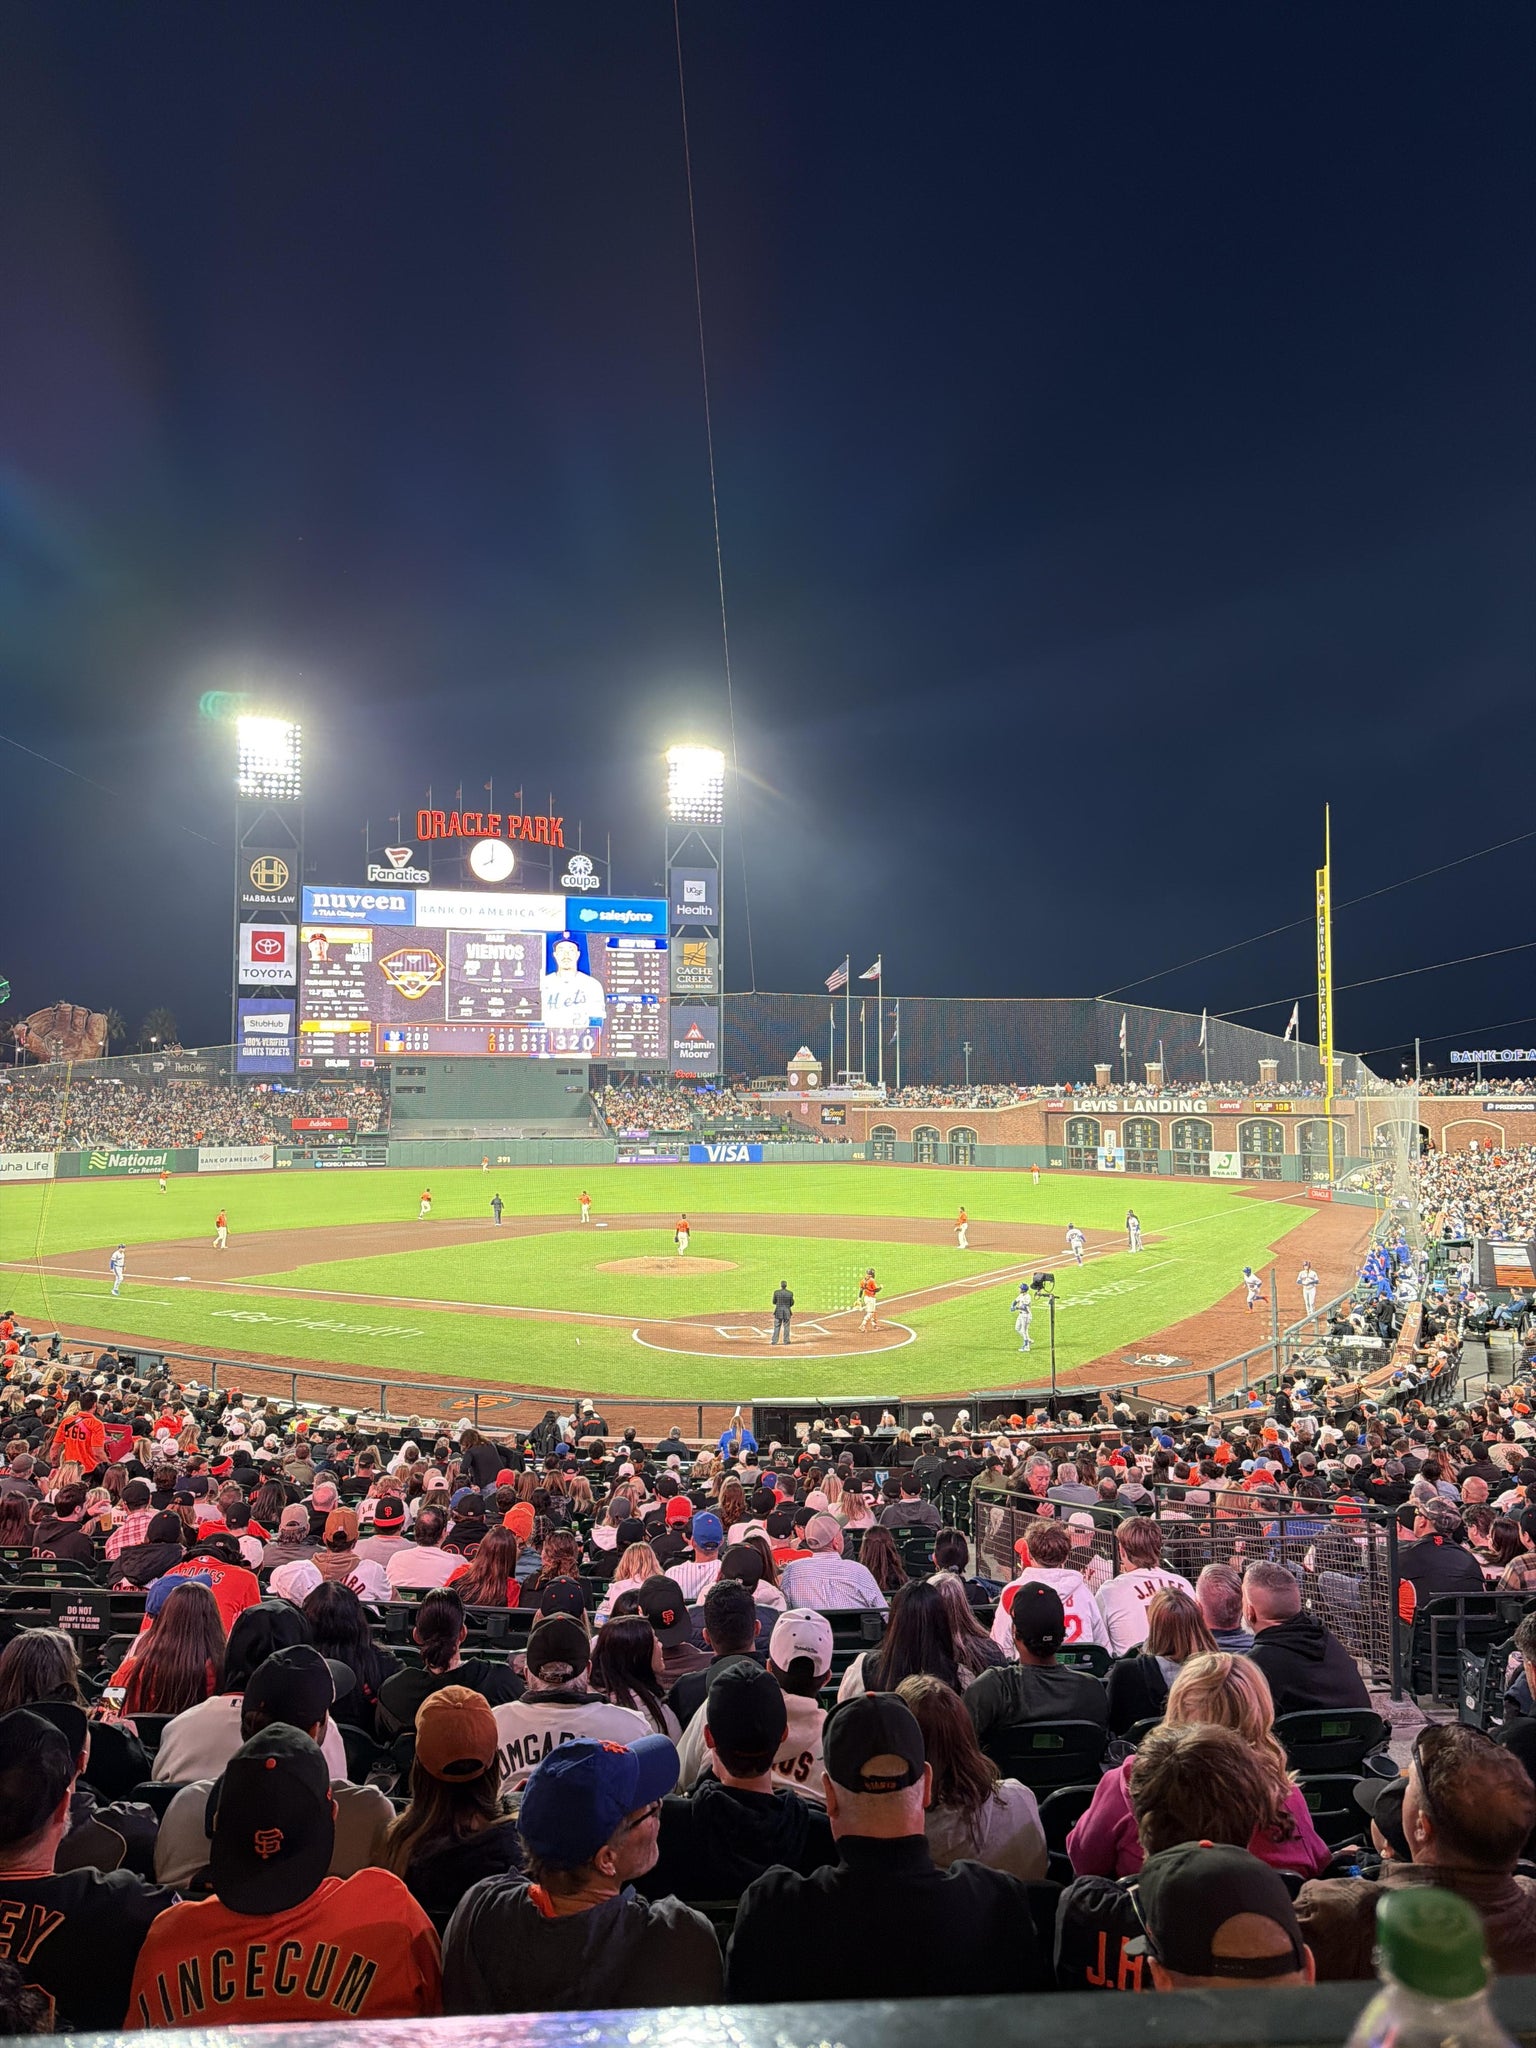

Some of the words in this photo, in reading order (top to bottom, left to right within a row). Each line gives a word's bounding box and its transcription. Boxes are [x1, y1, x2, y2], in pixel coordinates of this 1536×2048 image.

[417, 810, 501, 841] ORACLE
[508, 815, 564, 848] PARK
[370, 866, 428, 882] Fanatics
[563, 876, 598, 890] coupa
[242, 894, 276, 903] HABBAS
[278, 895, 295, 904] LAW
[312, 893, 406, 910] nuveen
[460, 906, 473, 915] OF
[478, 908, 535, 917] AMERICA
[677, 904, 712, 916] Health
[600, 910, 654, 924] salesforce
[466, 944, 525, 960] VIENTOS
[242, 968, 292, 978] TOYOTA
[676, 967, 713, 976] CACHE
[250, 1020, 284, 1028] StubHub
[262, 1038, 288, 1046] VERIFIED
[406, 1033, 412, 1041] 2
[415, 1033, 420, 1041] 0
[423, 1033, 429, 1041] 0
[489, 1033, 495, 1042] 2
[556, 1036, 566, 1049] 3
[570, 1036, 579, 1050] 2
[583, 1036, 594, 1050] 0
[406, 1042, 412, 1050] 0
[415, 1042, 420, 1050] 0
[423, 1042, 429, 1050] 0
[489, 1043, 495, 1051] 0
[674, 1040, 715, 1050] Benjamin
[243, 1048, 264, 1056] GIANTS
[265, 1048, 290, 1056] TICKETS
[680, 1050, 710, 1058] Moore
[1450, 1050, 1496, 1063] BANK
[1502, 1049, 1524, 1062] OF
[675, 1069, 696, 1078] Coors
[1124, 1100, 1207, 1112] LANDING
[108, 1152, 168, 1167] National
[704, 1146, 750, 1162] VISA
[26, 1160, 48, 1170] Life
[210, 1309, 286, 1322] UCSF
[273, 1317, 424, 1338] Health
[67, 1606, 77, 1615] DO
[78, 1606, 92, 1615] NOT
[138, 1940, 378, 2029] LINCECUM
